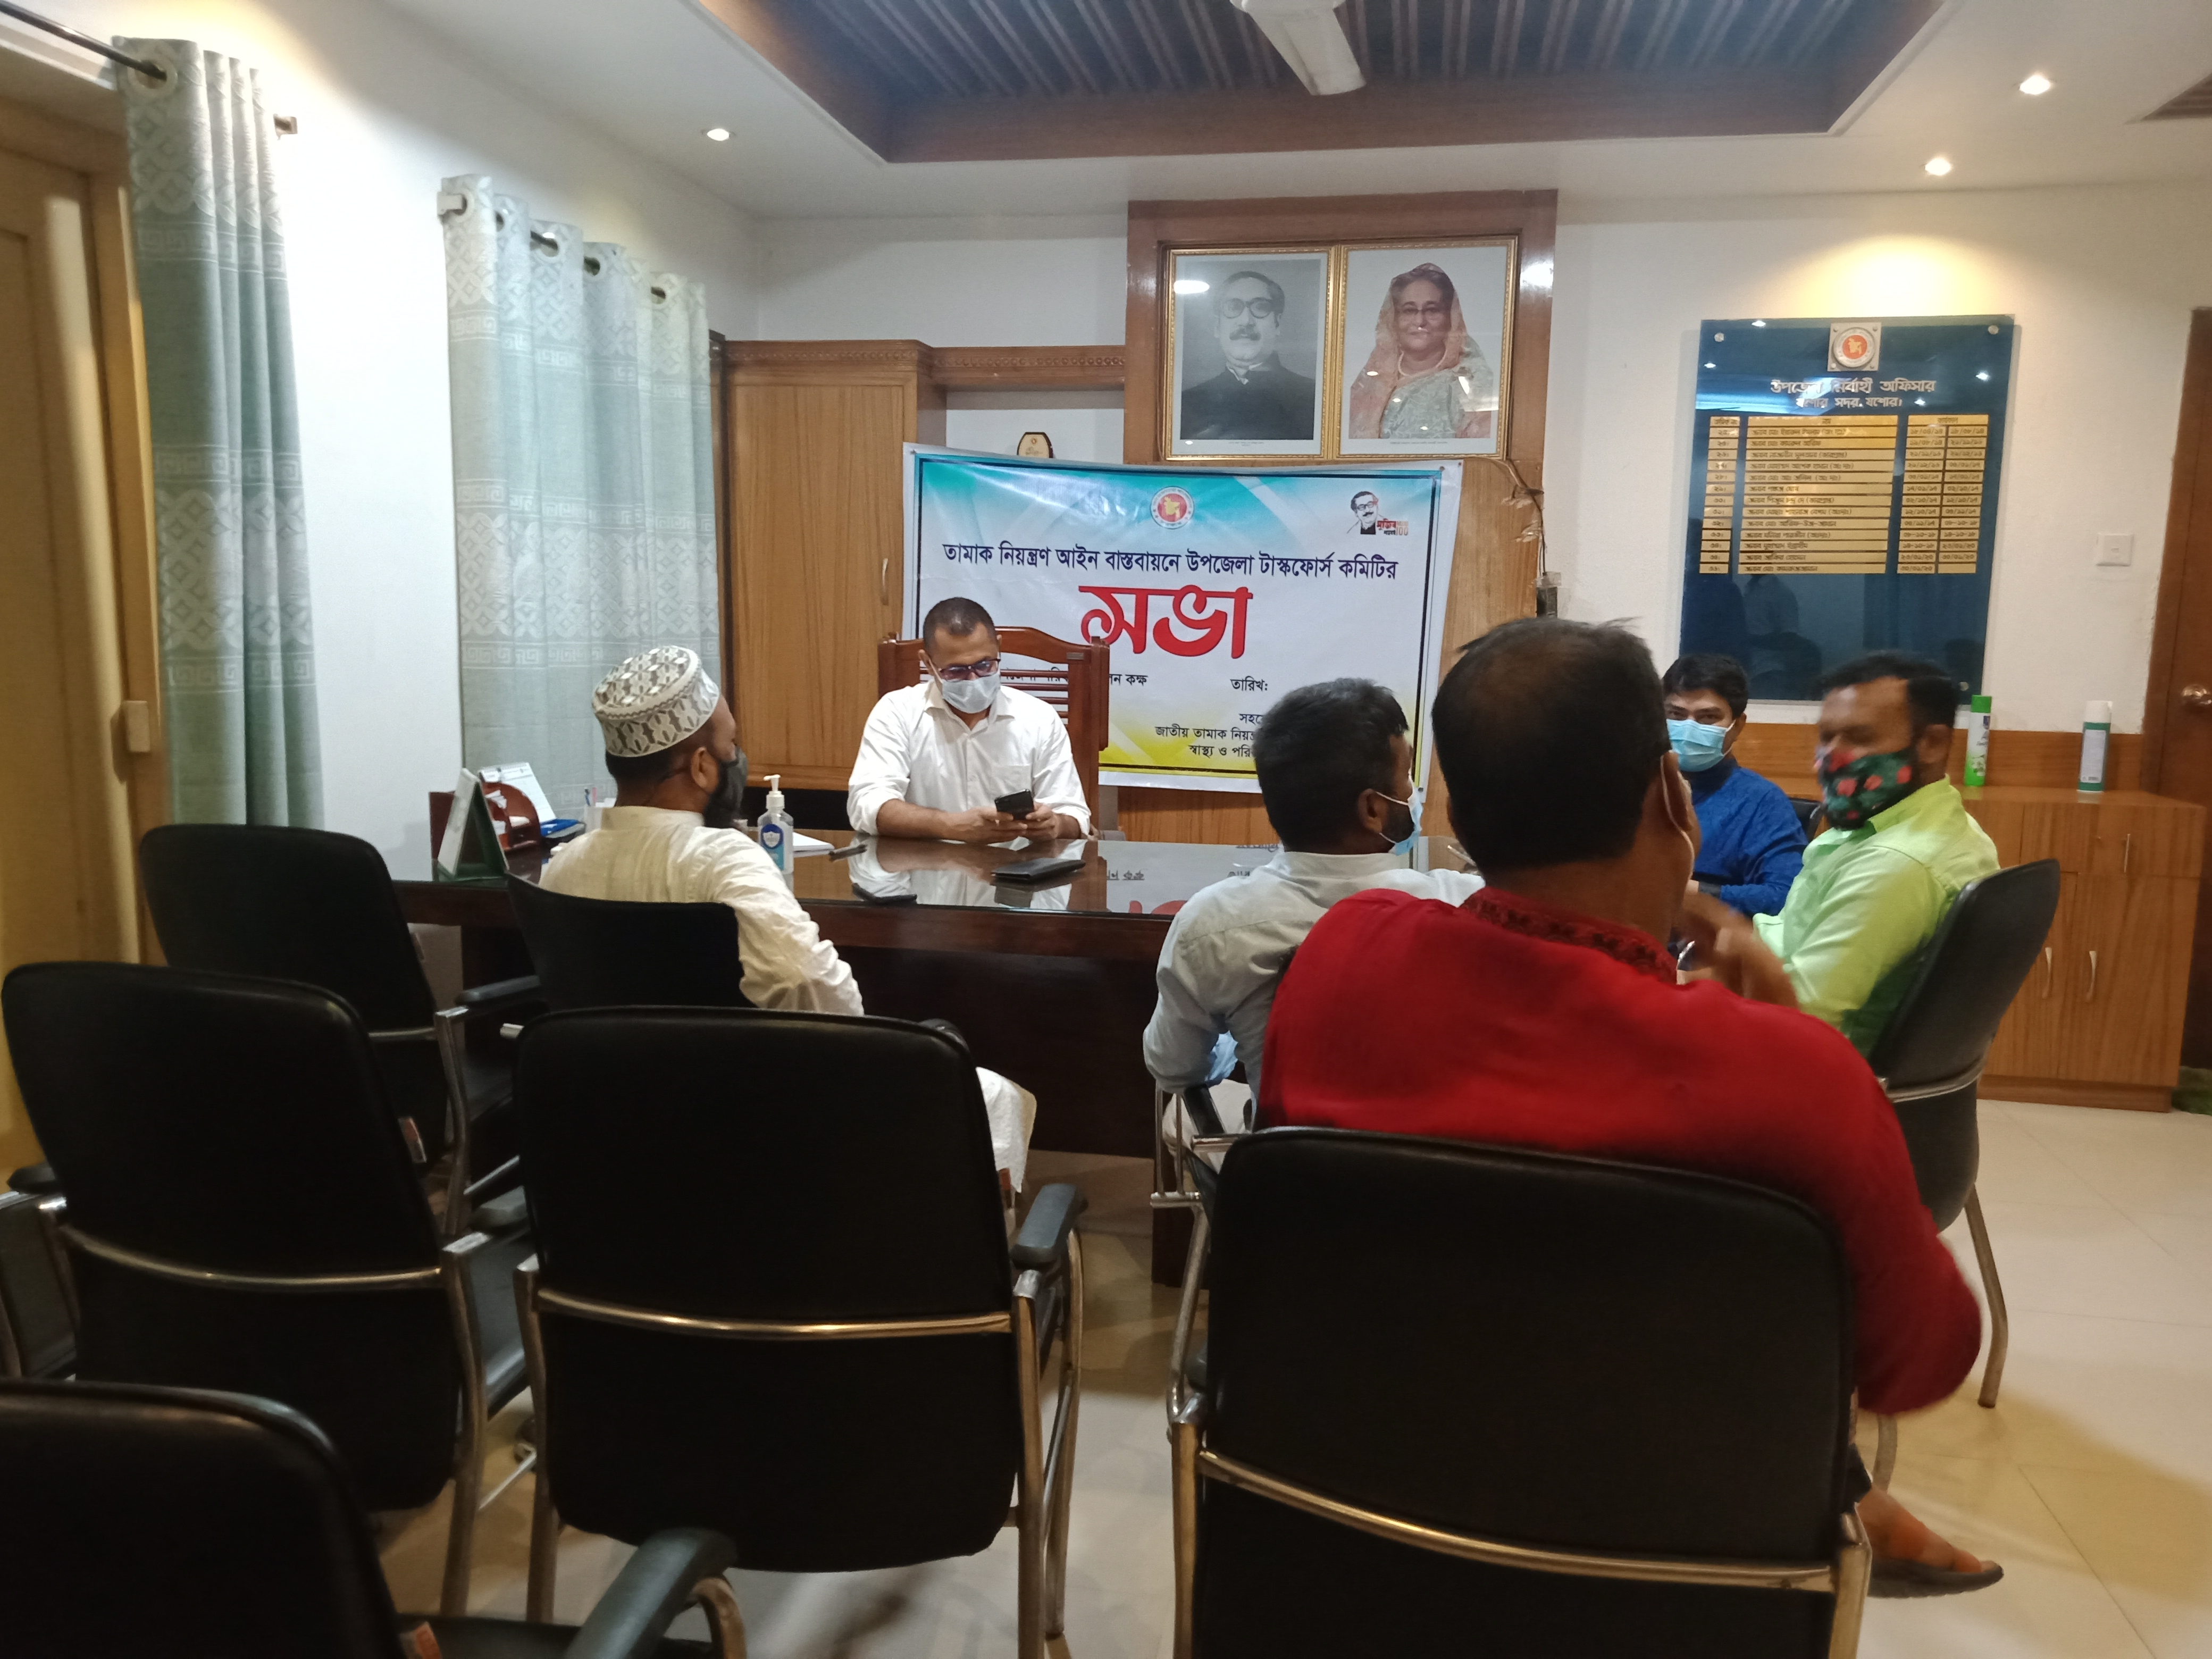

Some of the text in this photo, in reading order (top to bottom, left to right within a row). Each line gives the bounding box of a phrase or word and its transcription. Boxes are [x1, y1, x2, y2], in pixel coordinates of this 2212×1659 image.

[1831, 378, 1873, 394] নির্বাহী
[1880, 378, 1936, 392] অফিসার
[1796, 397, 1829, 408] যশোর
[942, 540, 1399, 580] তামাক নিয়ন্ত্রণ আইন বাস্তবায়নে উপজেলা টাস্কফোর্স কমিটির
[1078, 584, 1253, 659] সভা
[1125, 674, 1148, 686] কক্ষ
[1155, 724, 1189, 738] জাতীয়
[1192, 728, 1227, 740] তামাক
[1188, 744, 1214, 758] স্বাস্থ্য
[1219, 747, 1227, 756] ও
